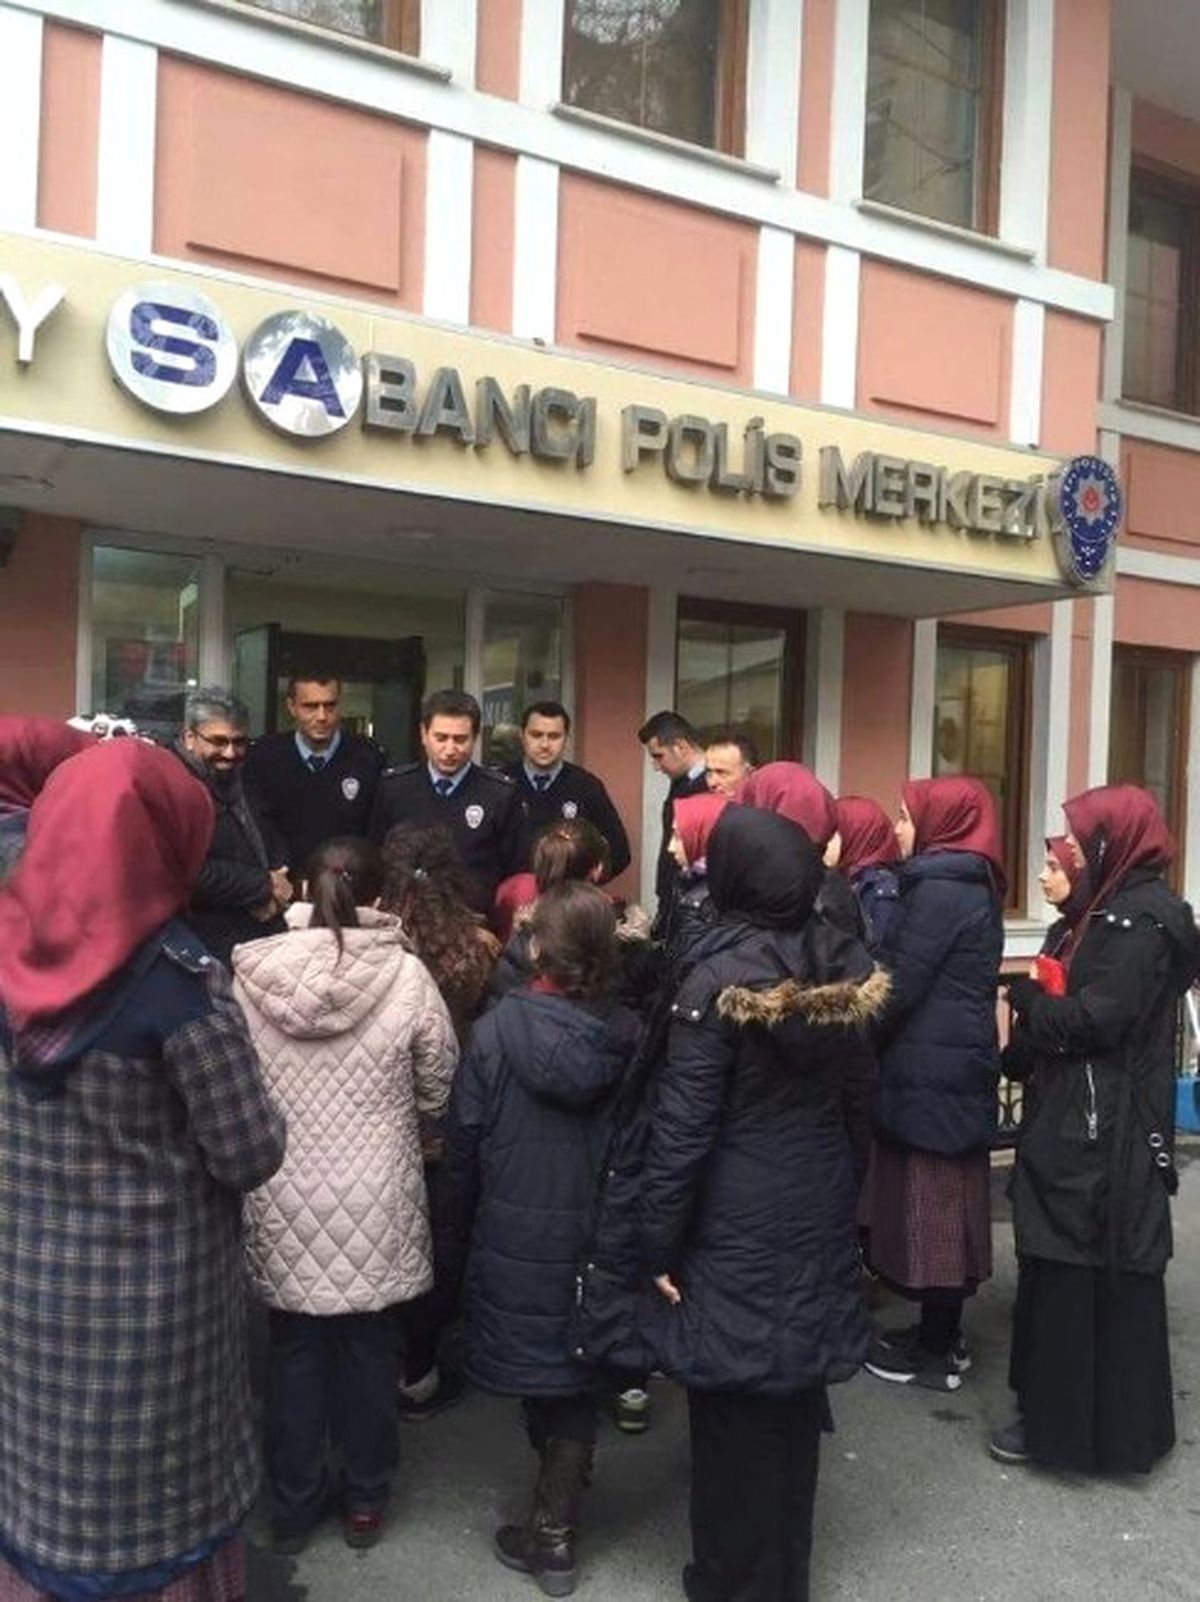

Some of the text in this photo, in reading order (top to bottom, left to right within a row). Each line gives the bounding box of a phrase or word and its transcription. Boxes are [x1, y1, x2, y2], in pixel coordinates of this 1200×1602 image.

[129, 300, 597, 468] SABANCI
[621, 404, 803, 499] POLİS
[820, 446, 1045, 540] MERKEZİ
